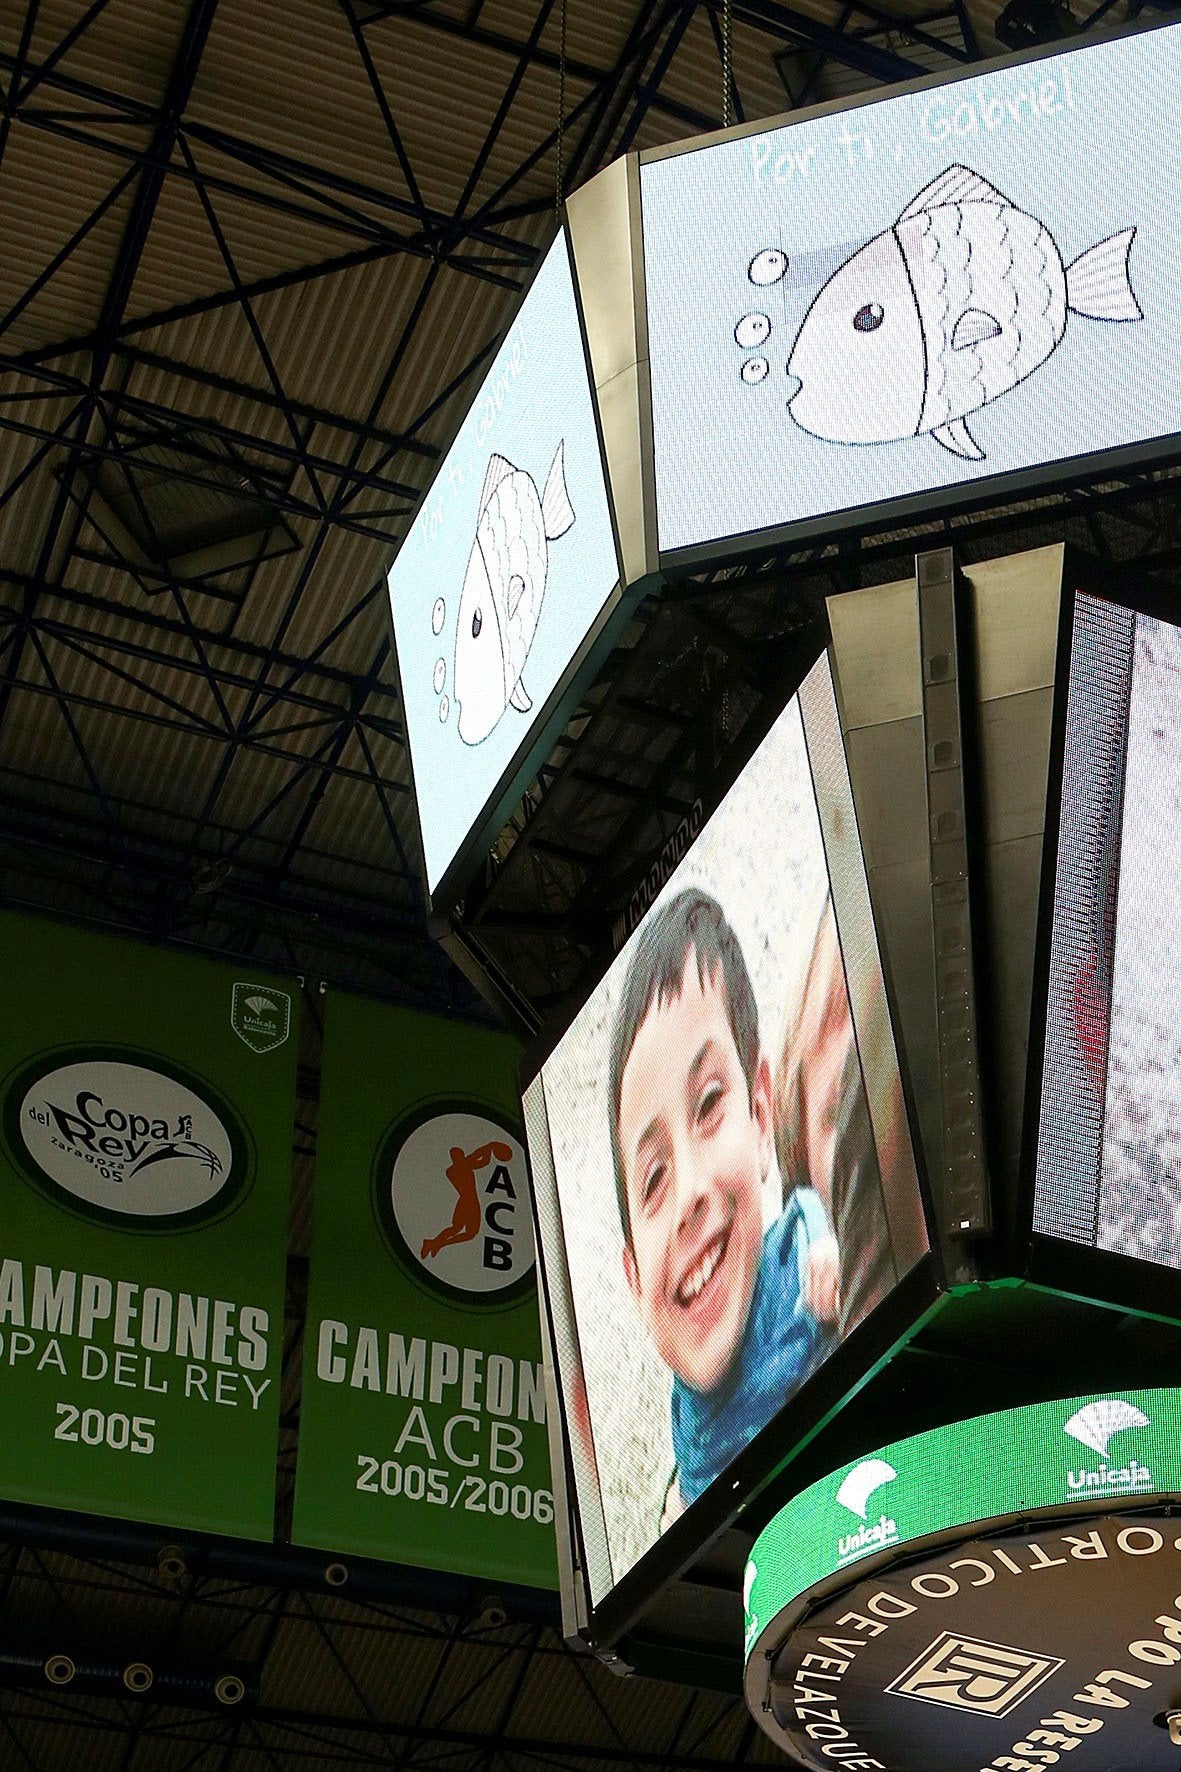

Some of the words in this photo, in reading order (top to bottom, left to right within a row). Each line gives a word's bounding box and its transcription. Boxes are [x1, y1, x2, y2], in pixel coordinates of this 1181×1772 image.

[751, 135, 813, 192] Por
[921, 66, 1076, 142] Gabriel
[29, 1107, 50, 1128] del
[44, 1100, 152, 1163] Rey
[76, 1091, 168, 1141] Copa
[484, 1164, 518, 1272] ACB
[0, 1258, 269, 1371] AMPEONES
[81, 1344, 168, 1395] DEL
[185, 1363, 272, 1411] REY
[317, 1319, 548, 1425] CAMPEON
[54, 1402, 156, 1455] 2005
[394, 1405, 525, 1475] ACB
[356, 1455, 555, 1525] 2005/2006
[1066, 1460, 1152, 1490] Unicaja
[835, 1591, 919, 1638] DE
[1072, 1669, 1154, 1710] LA
